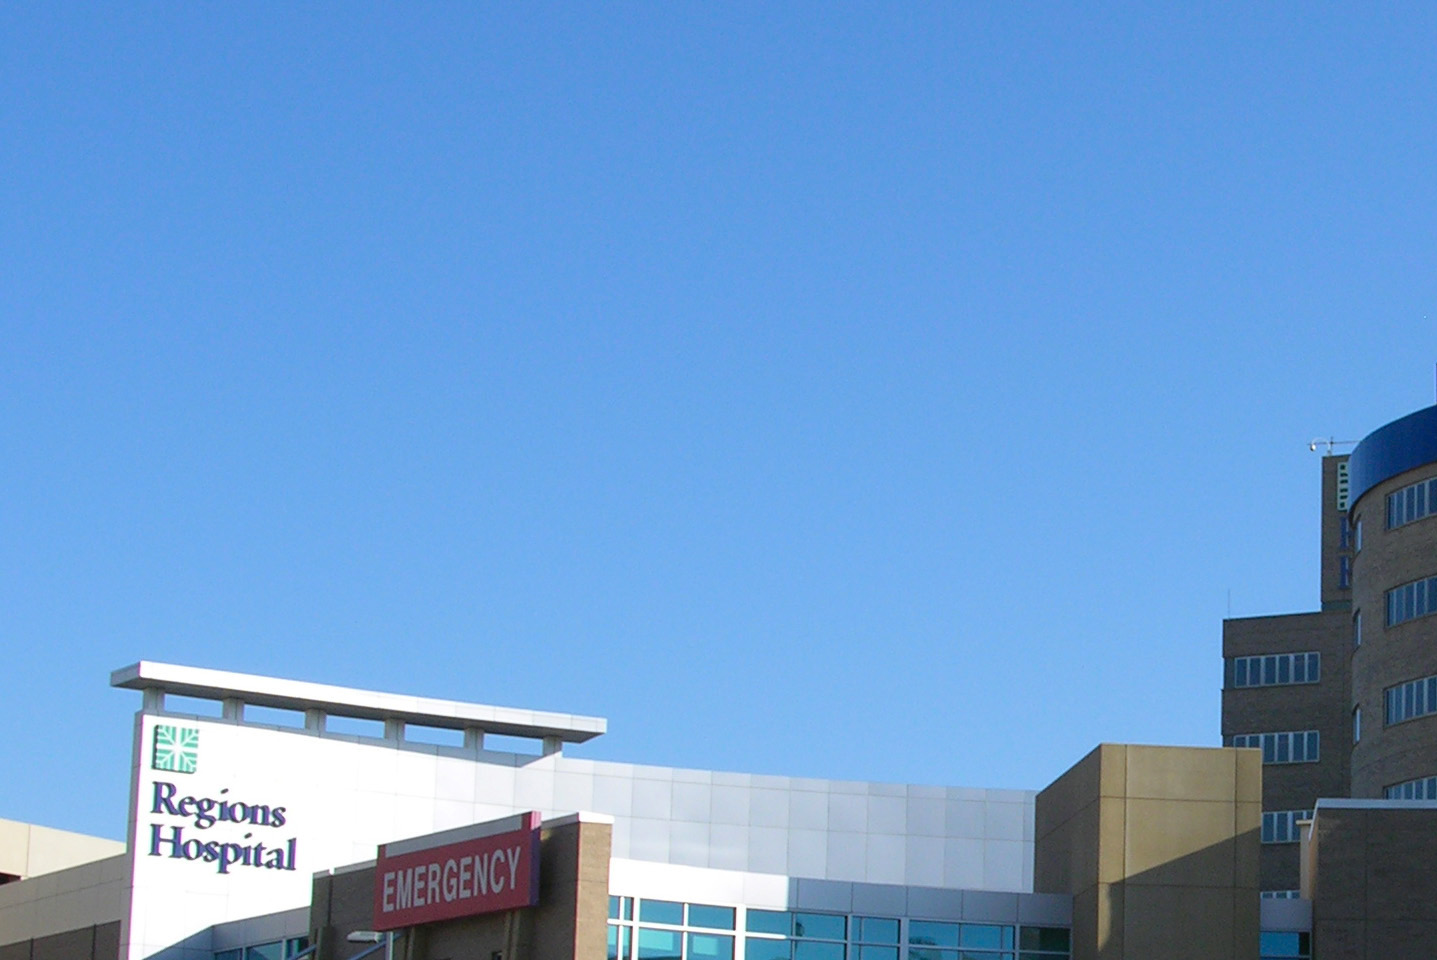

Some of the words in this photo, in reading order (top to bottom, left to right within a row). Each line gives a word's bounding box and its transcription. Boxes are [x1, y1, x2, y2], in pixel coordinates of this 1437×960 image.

[150, 781, 286, 829] Regions
[148, 823, 297, 874] Hospital
[382, 846, 521, 912] EMERGENCY
